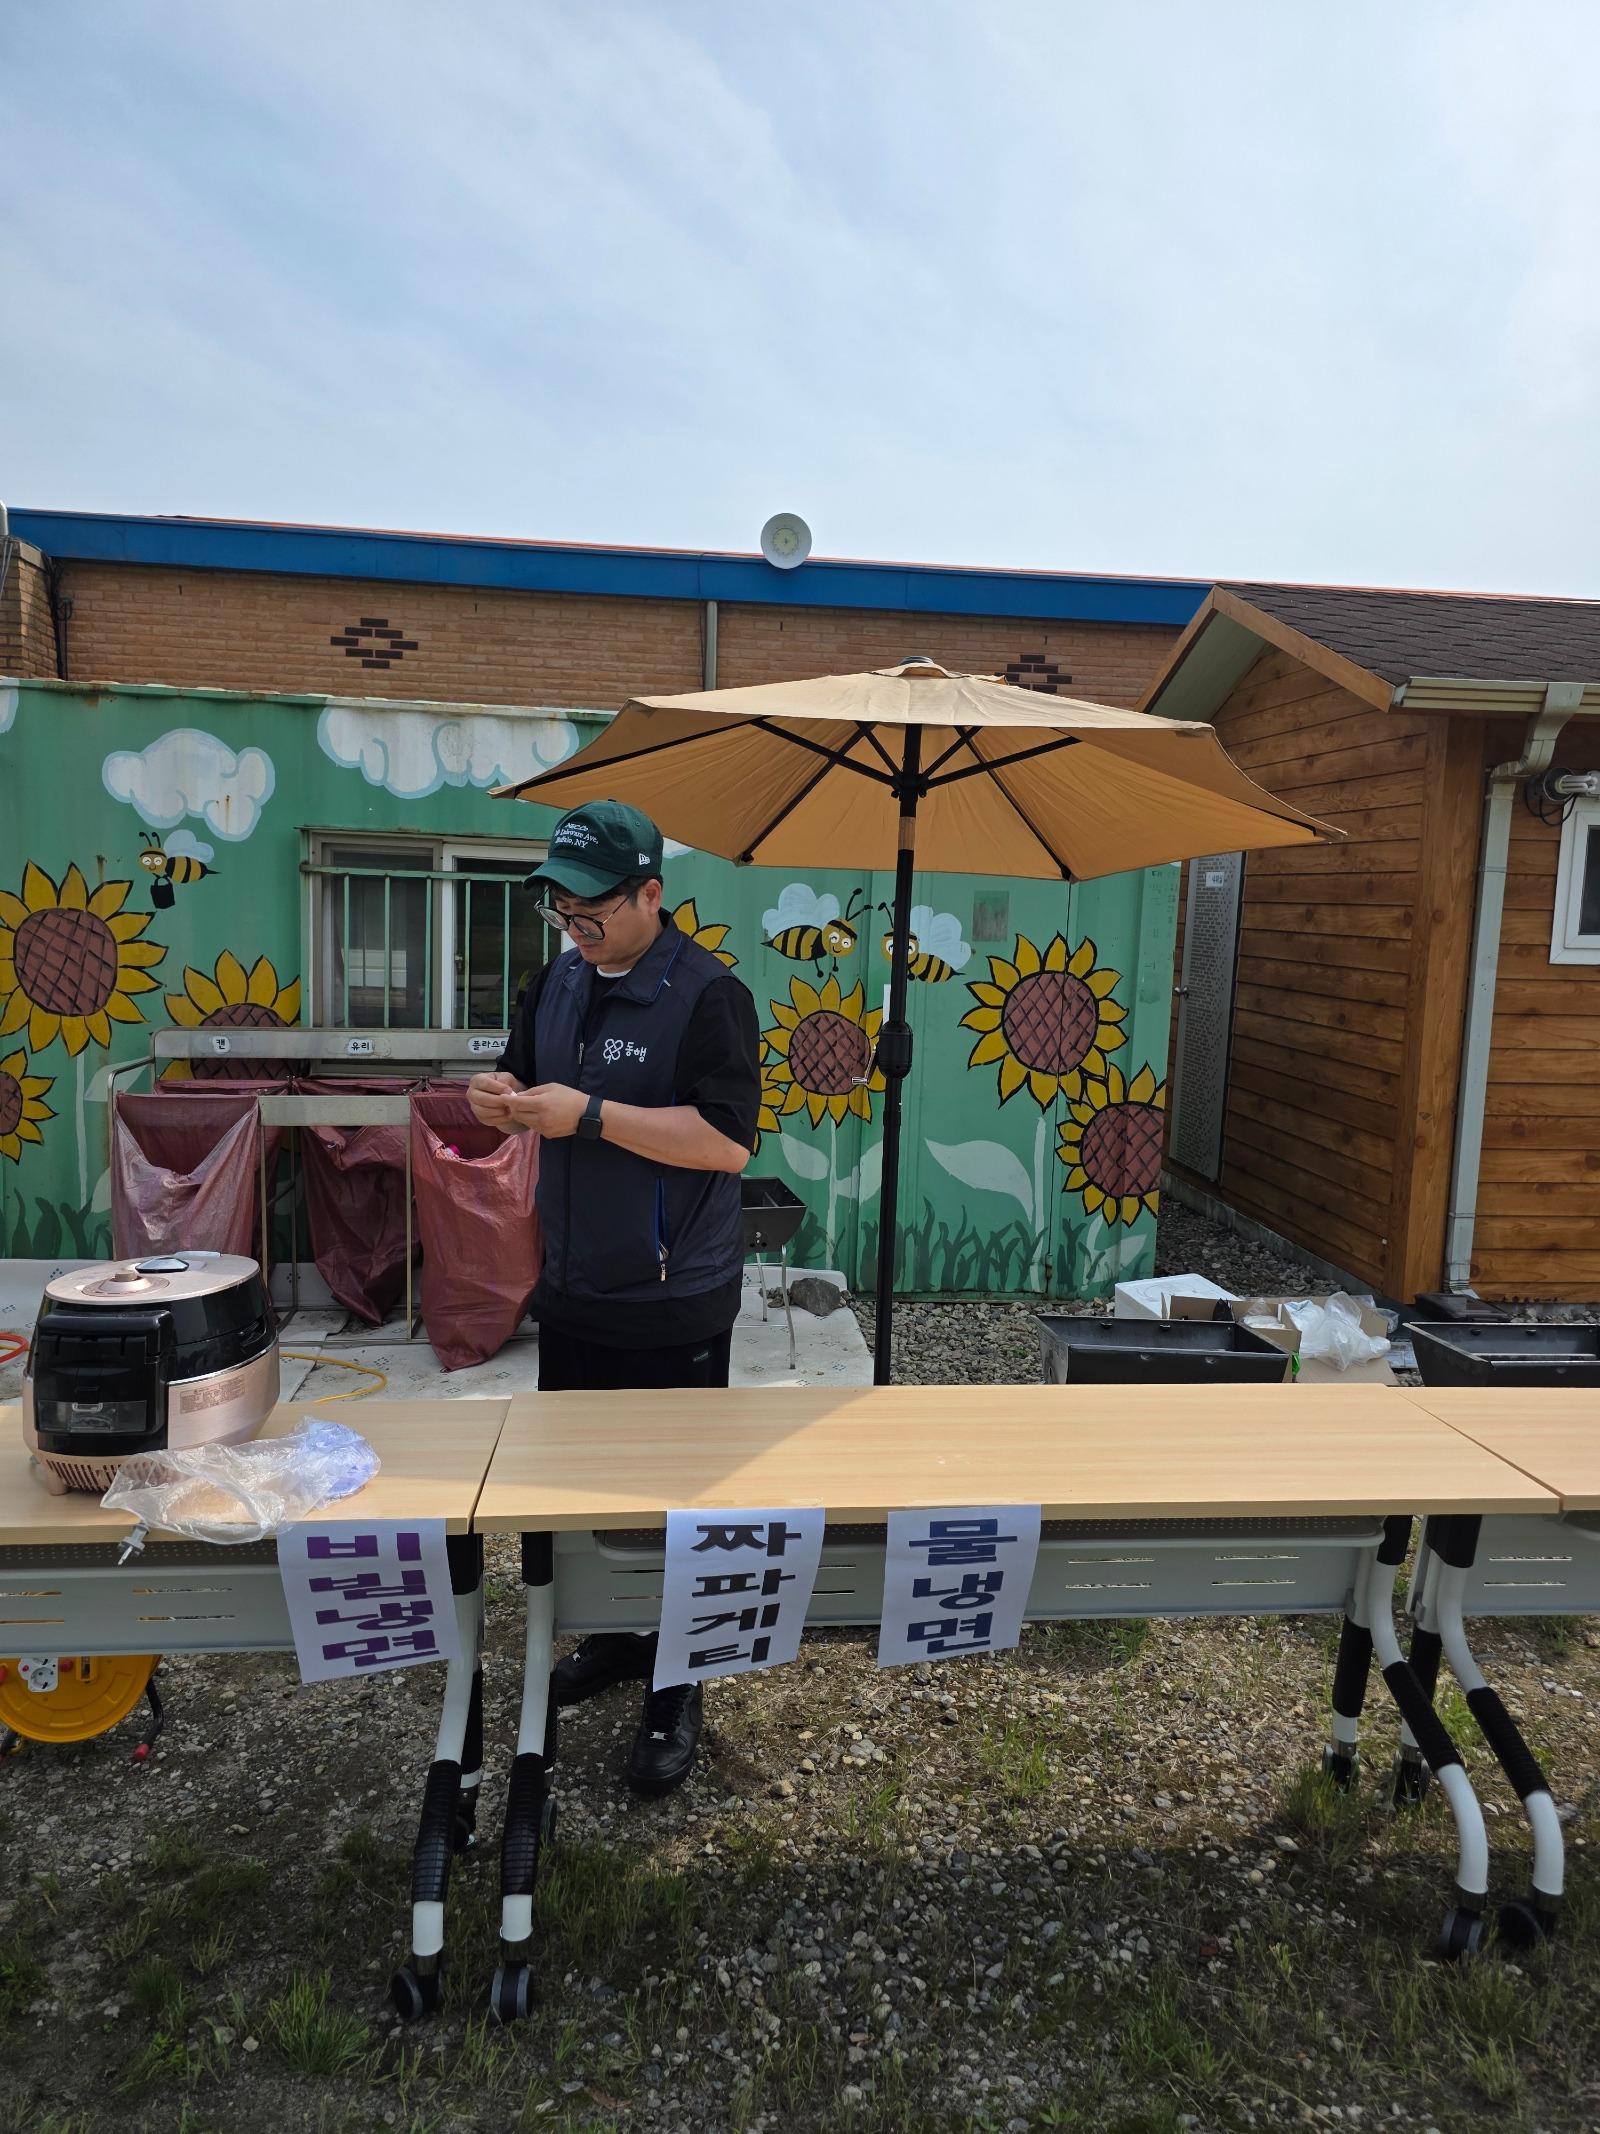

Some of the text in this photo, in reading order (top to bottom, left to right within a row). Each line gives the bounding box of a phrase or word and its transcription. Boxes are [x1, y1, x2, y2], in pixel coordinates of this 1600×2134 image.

[574, 838, 589, 849] NY
[216, 1039, 226, 1049] 캔
[351, 1041, 370, 1051] 유리
[625, 1041, 648, 1063] 동행
[685, 1522, 802, 1669] 짜파게티
[907, 1519, 1018, 1654] 물냉면
[306, 1533, 440, 1667] 비빔냉면
